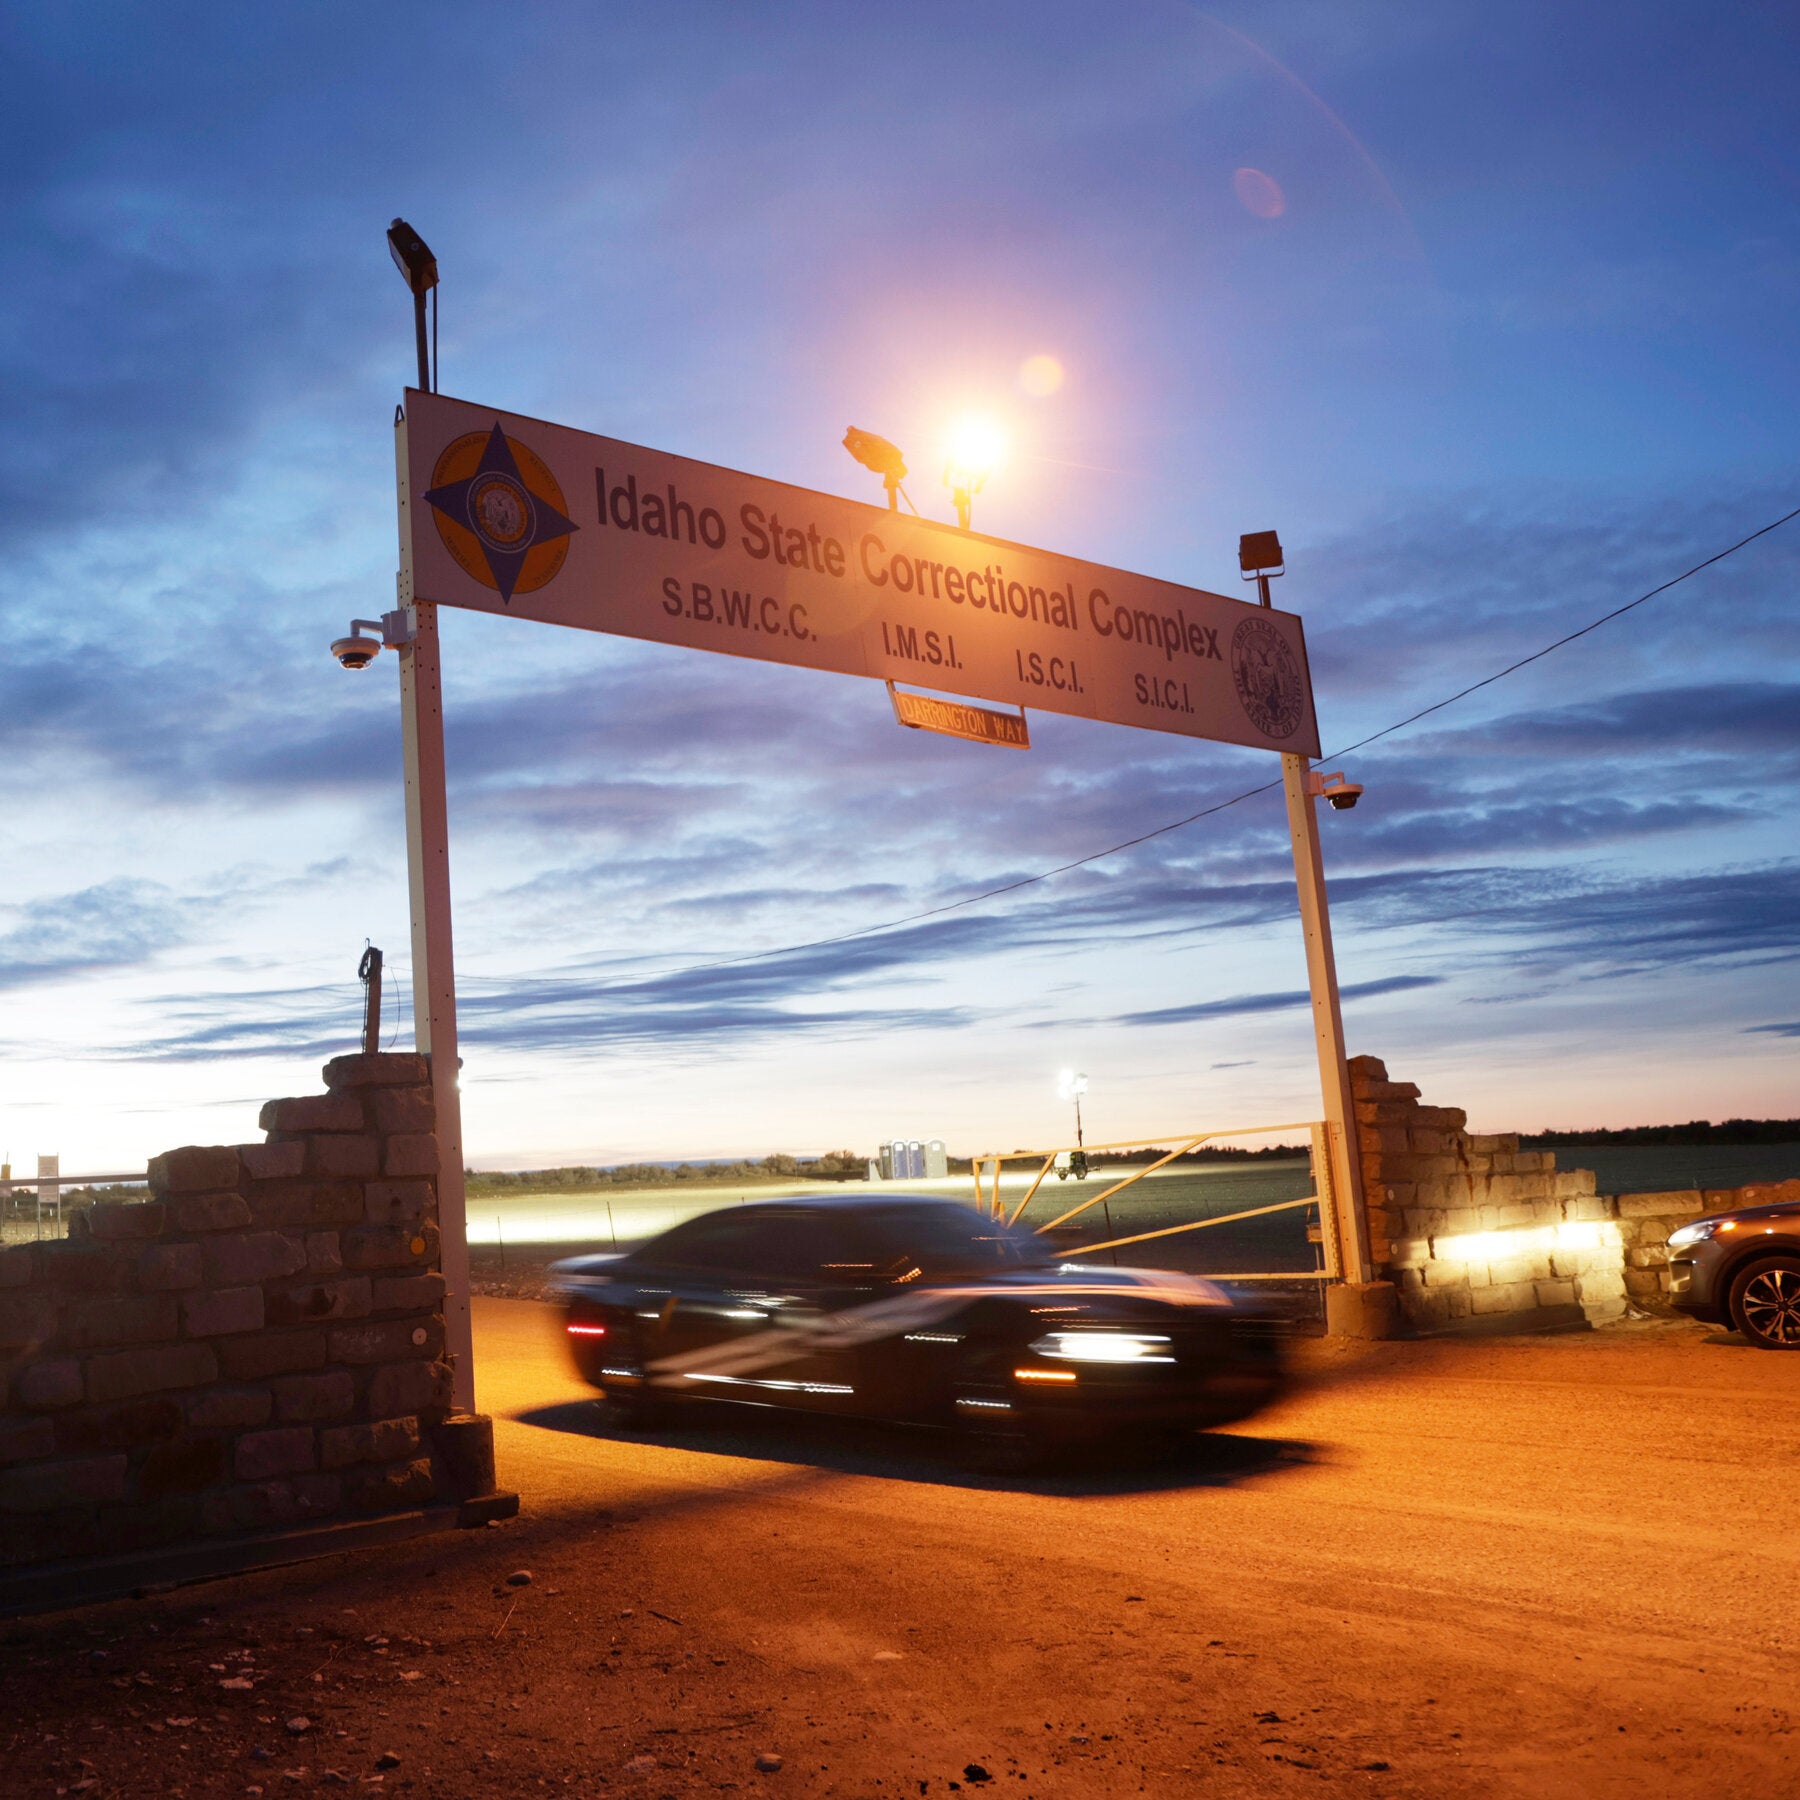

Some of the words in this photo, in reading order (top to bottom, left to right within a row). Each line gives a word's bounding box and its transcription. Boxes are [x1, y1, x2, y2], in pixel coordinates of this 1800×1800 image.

[595, 466, 726, 550] Idaho
[740, 503, 846, 578] State
[859, 533, 1078, 631] Correctional
[1089, 588, 1223, 662] Complex
[661, 577, 818, 642] S.B.W.C.C.
[882, 622, 963, 669] I.M.S.I.
[1016, 649, 1084, 693] I.S.C.I.
[1135, 673, 1195, 714] S.I.C.I.
[901, 697, 988, 736] DARRINGTON
[993, 716, 1023, 742] WAY
